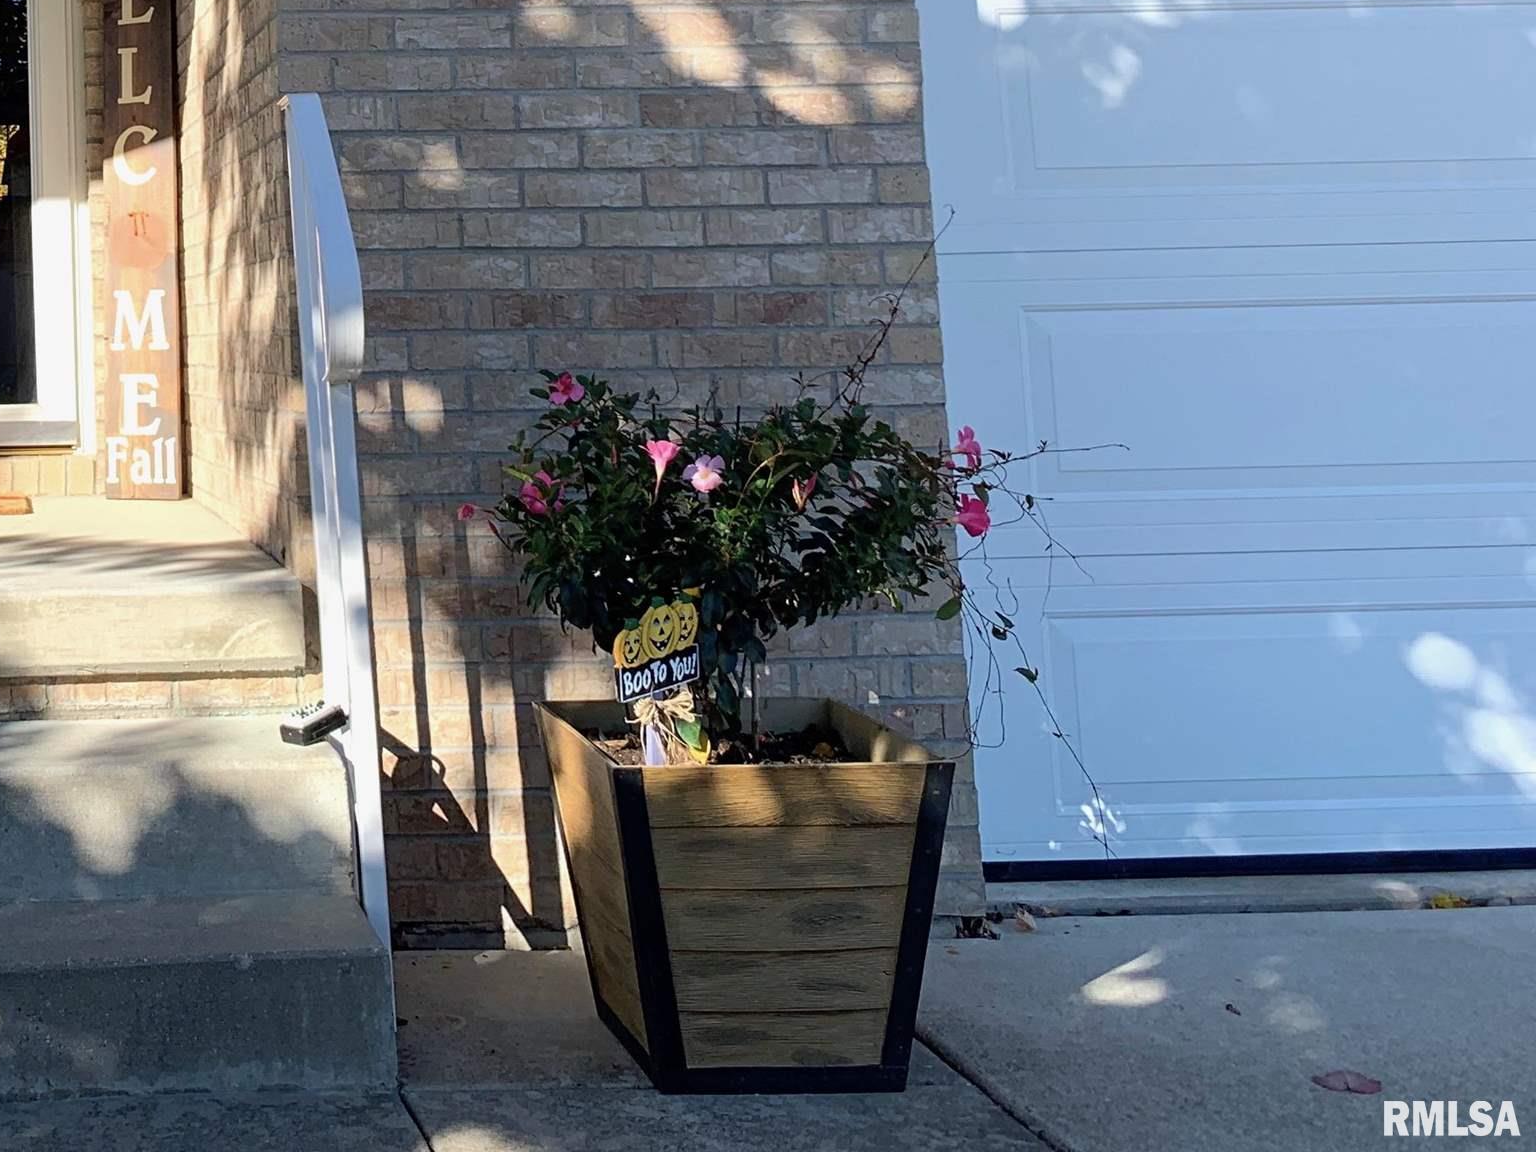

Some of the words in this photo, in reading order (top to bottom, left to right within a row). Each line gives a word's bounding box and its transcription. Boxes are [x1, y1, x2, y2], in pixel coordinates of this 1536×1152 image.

[105, 436, 176, 485] Fall
[623, 668, 652, 696] BOO
[650, 660, 667, 684] TO
[669, 652, 697, 681] YOU!
